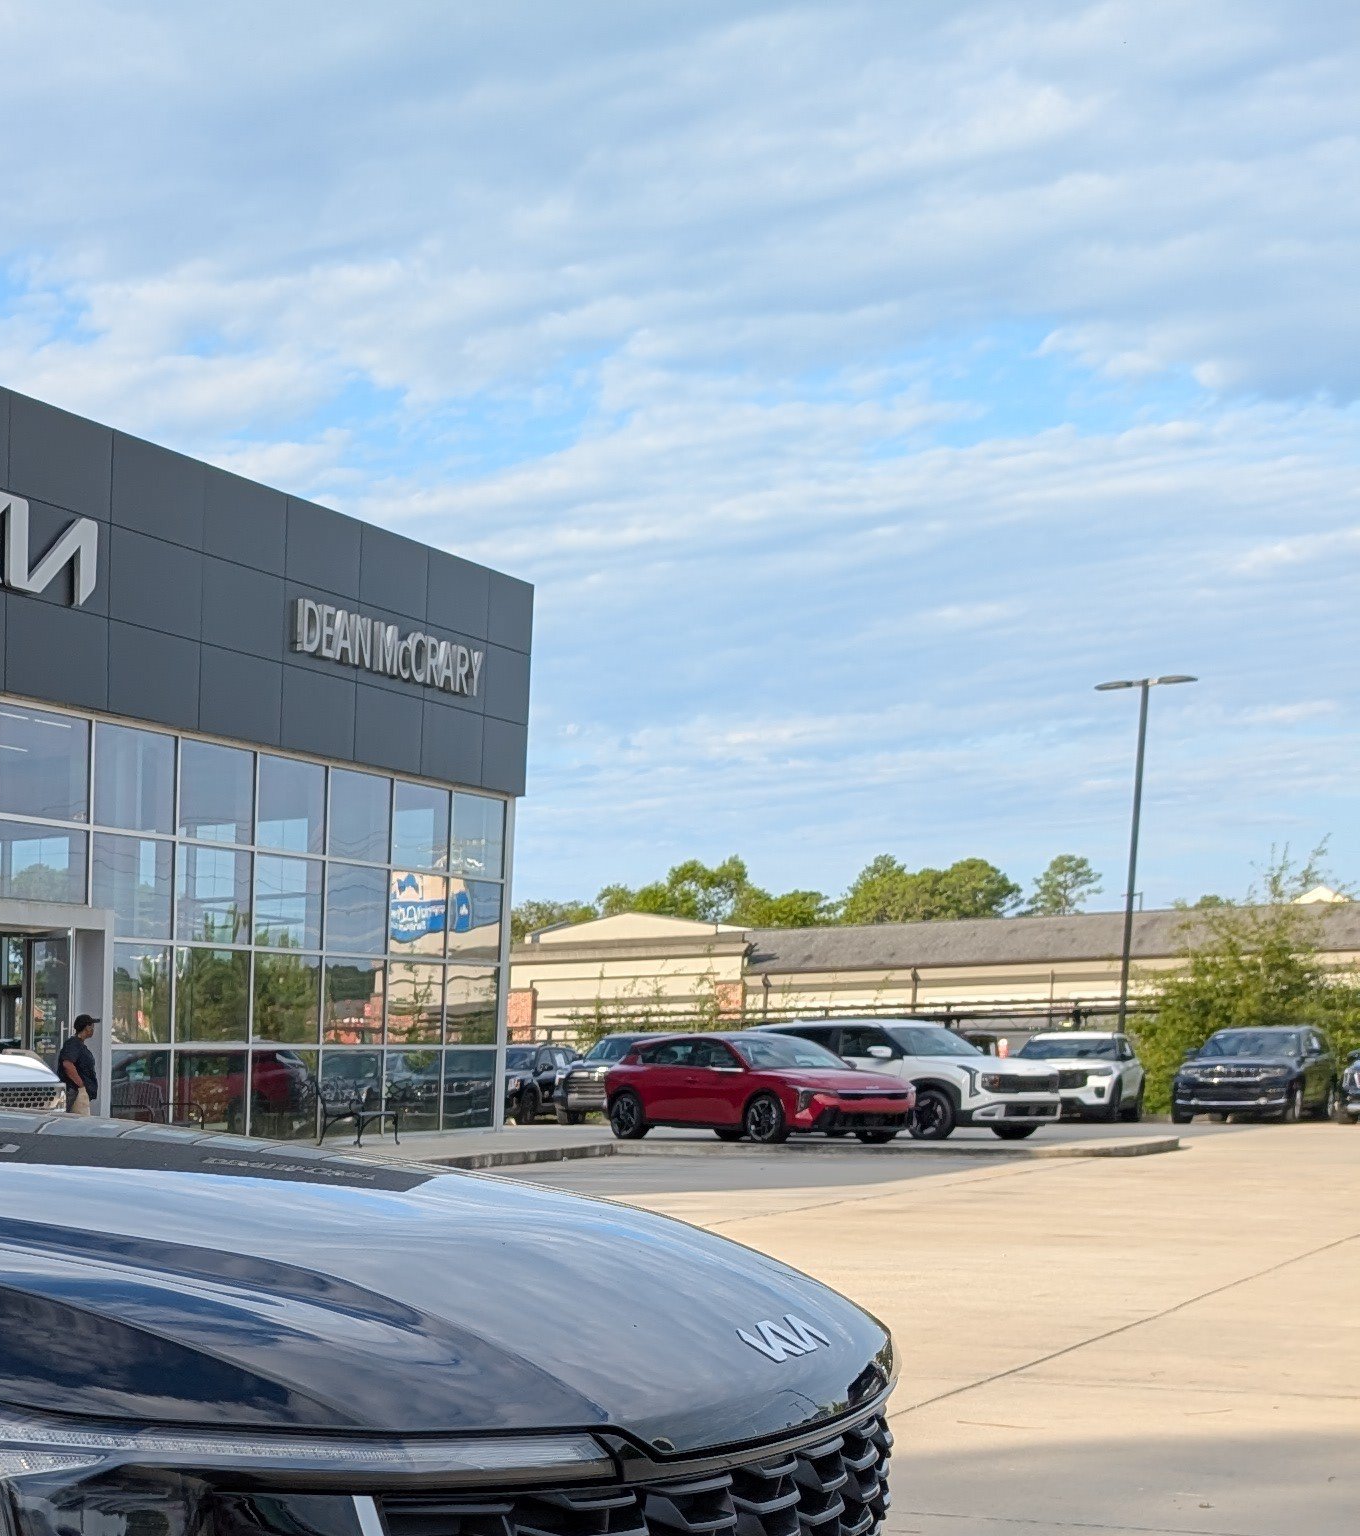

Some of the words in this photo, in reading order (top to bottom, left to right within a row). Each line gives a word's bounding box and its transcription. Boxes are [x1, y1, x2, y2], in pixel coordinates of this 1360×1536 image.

[296, 598, 372, 671] DEAN
[372, 622, 484, 697] McCRARY
[735, 1313, 832, 1364] KIA
